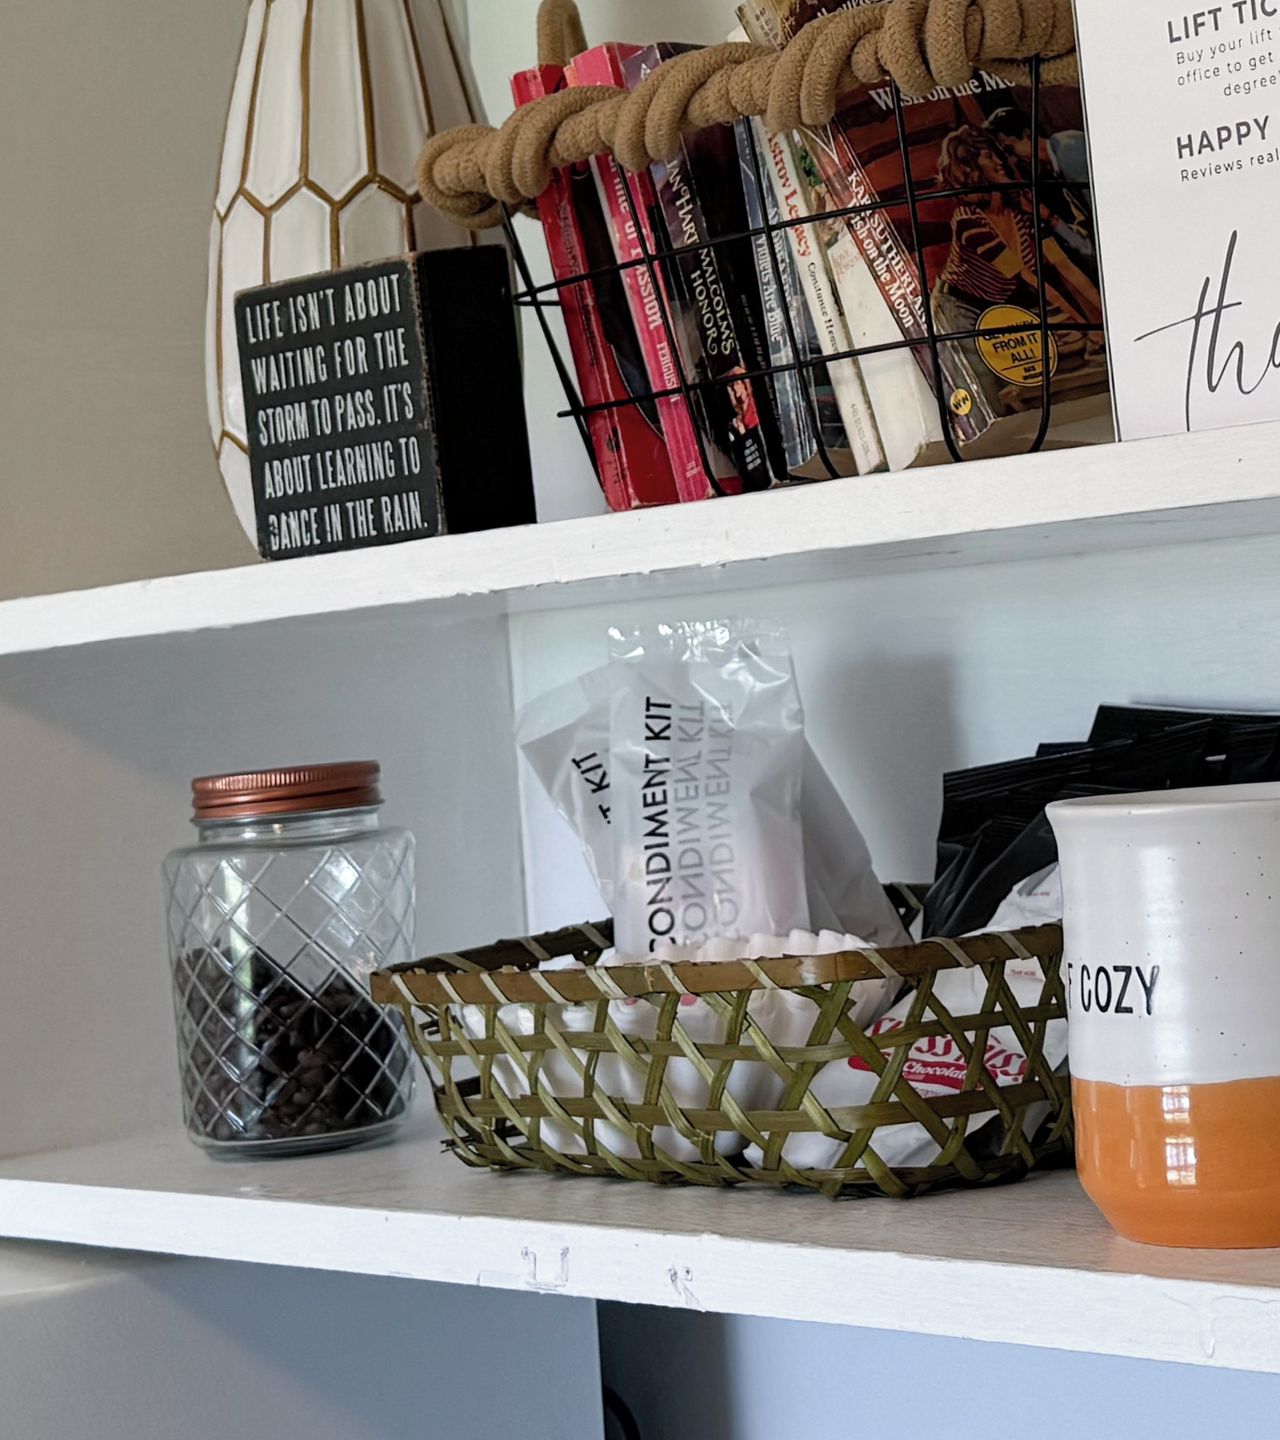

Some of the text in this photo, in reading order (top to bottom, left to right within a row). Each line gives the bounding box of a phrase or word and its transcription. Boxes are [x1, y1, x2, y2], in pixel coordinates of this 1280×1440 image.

[1166, 6, 1223, 44] LIFT
[1175, 48, 1204, 65] Buy
[1208, 38, 1243, 60] your
[1248, 28, 1273, 46] lift
[1176, 66, 1220, 86] office
[1225, 61, 1242, 74] to
[1247, 51, 1274, 72] get
[1175, 114, 1270, 160] HAPPY
[1179, 159, 1243, 183] Reviews
[698, 246, 736, 356] MALCOLM'S
[861, 234, 917, 330] on the Moon
[245, 273, 401, 344] LIFE ISN'T ABOUT
[690, 270, 719, 356] HONOR
[252, 327, 409, 395] WAITING FOR THE
[992, 332, 1039, 355] FROM IT
[1011, 348, 1037, 365] ALL!
[258, 381, 414, 447] STORM TO PASS. IT'S
[264, 436, 420, 499] ABOUT LEARNING TO
[270, 491, 428, 551] DANCE IN THE RAIN.
[644, 696, 672, 742] KIT
[571, 751, 611, 794] KIT
[1080, 964, 1160, 1016] COZY
